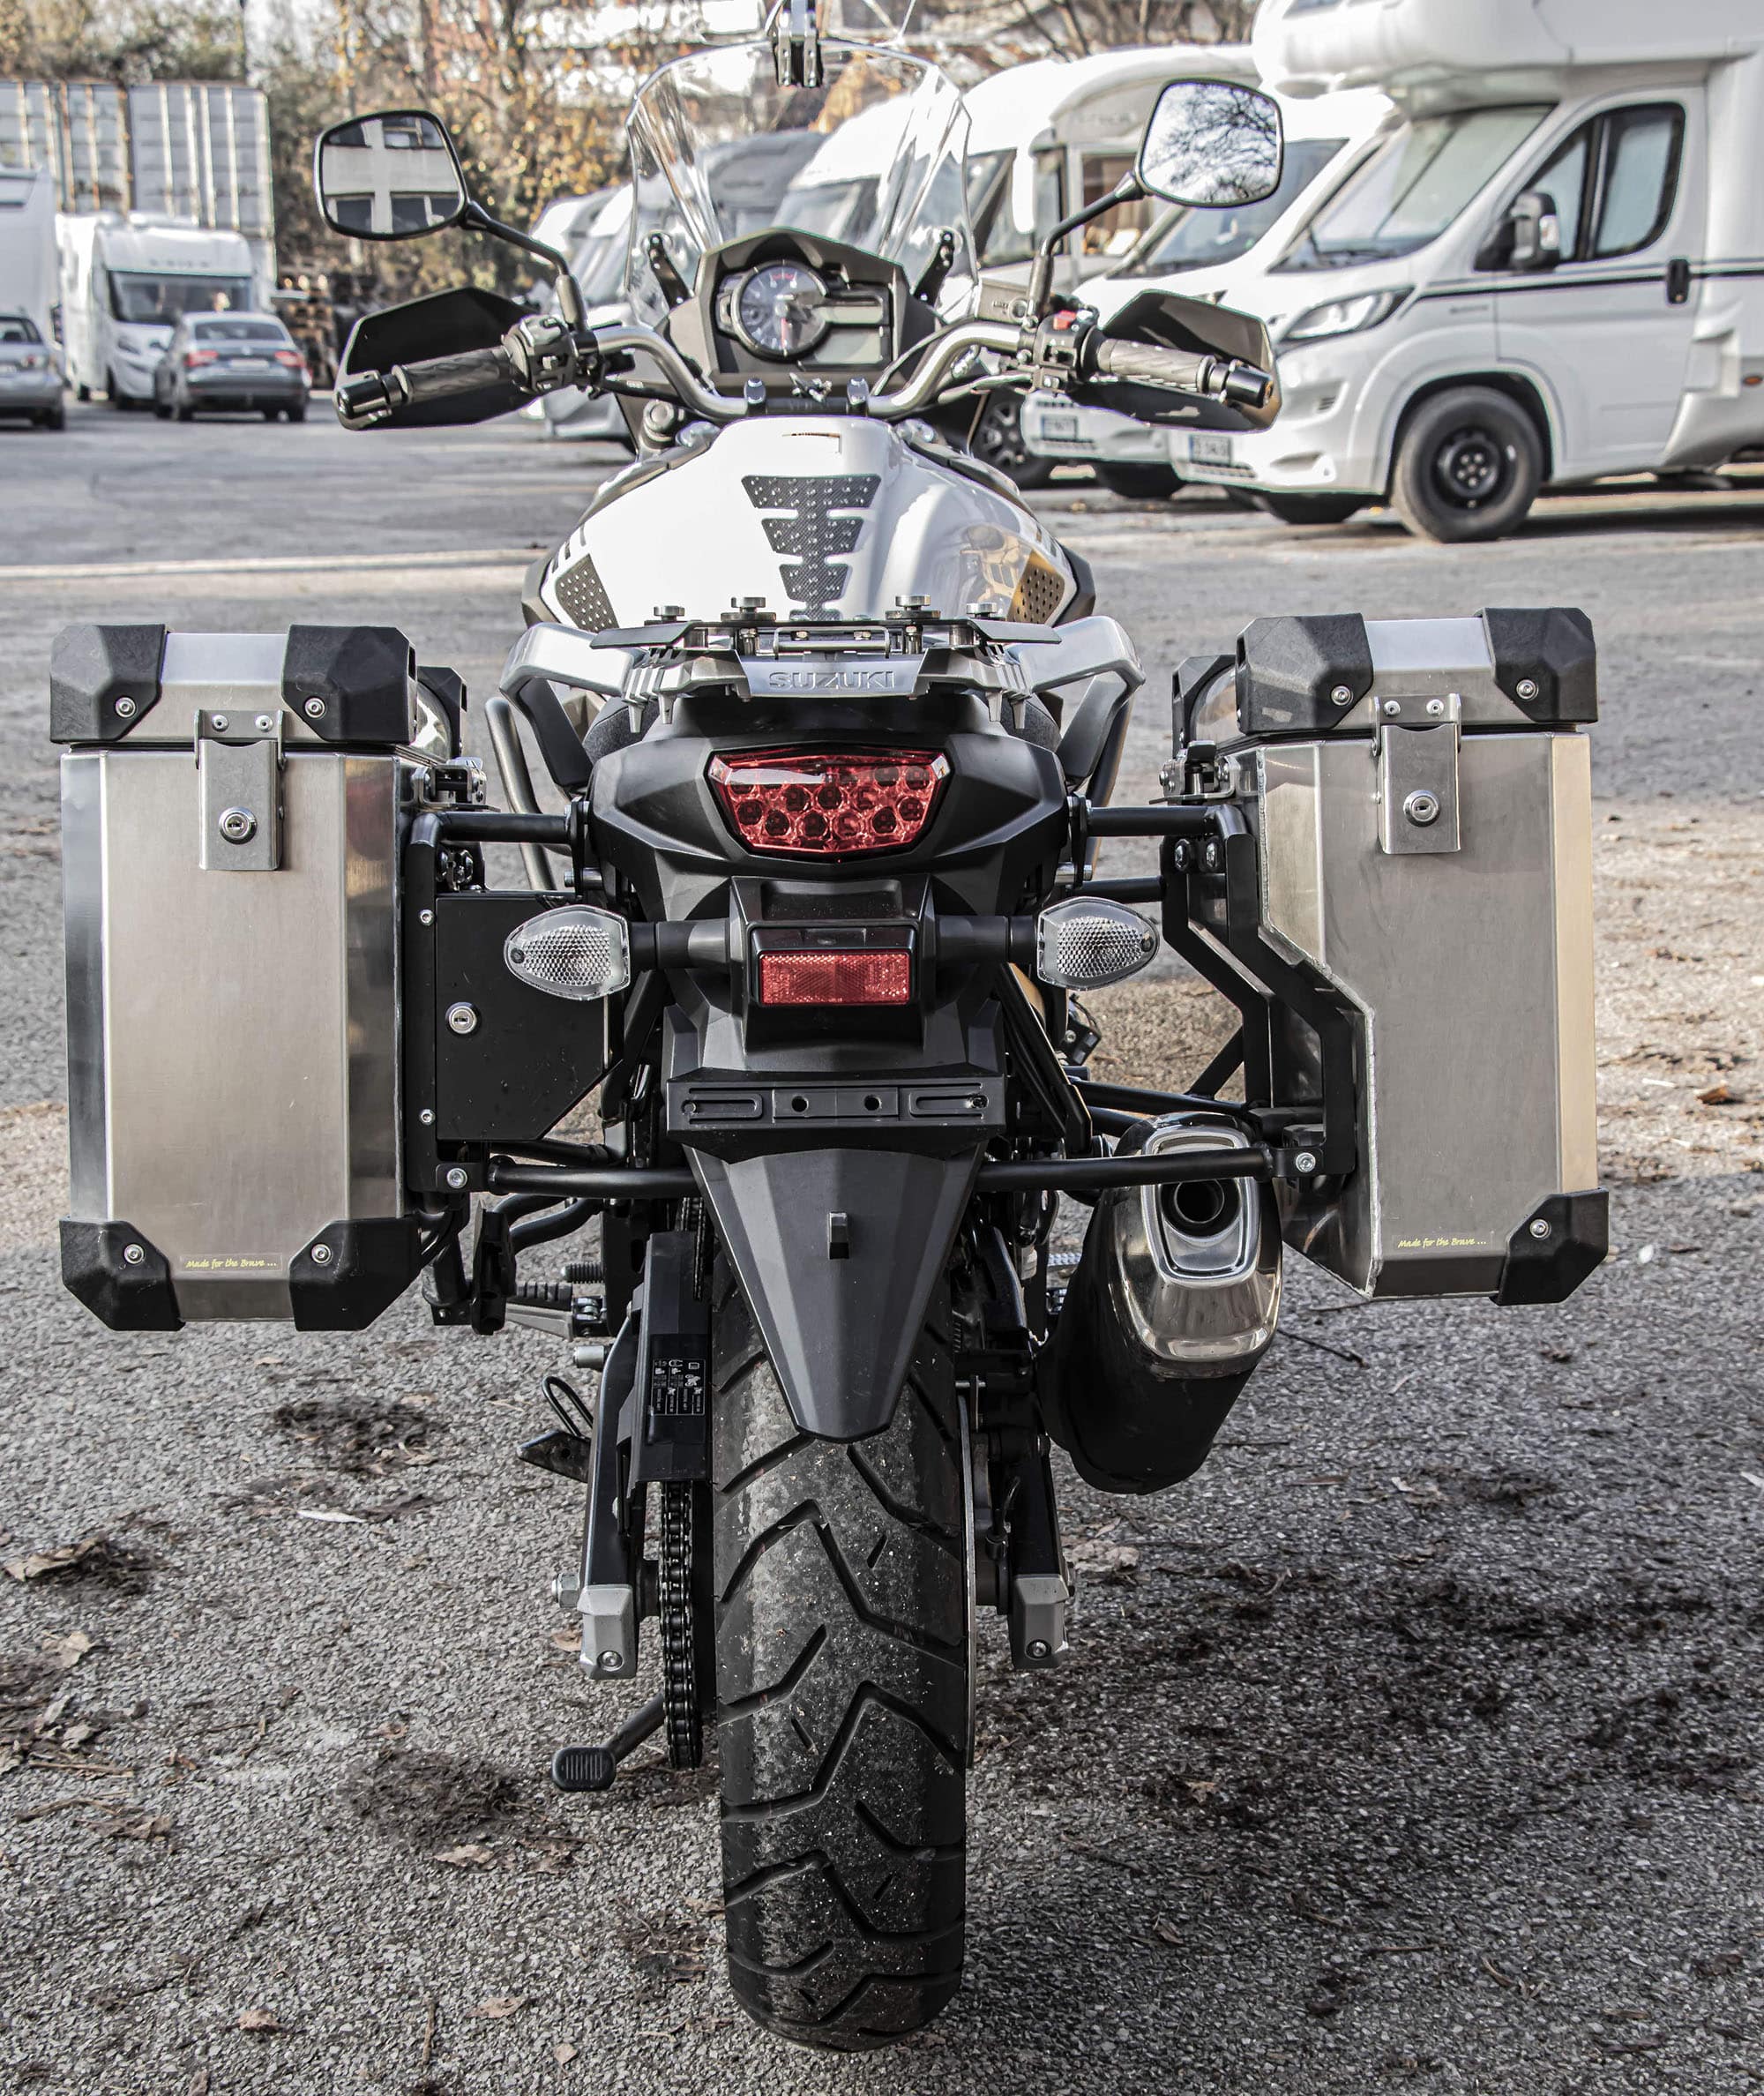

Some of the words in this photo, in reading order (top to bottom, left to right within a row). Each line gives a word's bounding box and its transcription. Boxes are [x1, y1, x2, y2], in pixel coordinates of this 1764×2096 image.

[769, 671, 895, 690] SUZUKI
[1397, 1238, 1422, 1248] Made
[1422, 1237, 1436, 1249] for
[1436, 1237, 1449, 1246] the
[1451, 1238, 1476, 1246] Brave
[185, 1259, 210, 1268] Made
[211, 1258, 224, 1269] for
[225, 1258, 238, 1268] the
[240, 1259, 265, 1268] Brave
